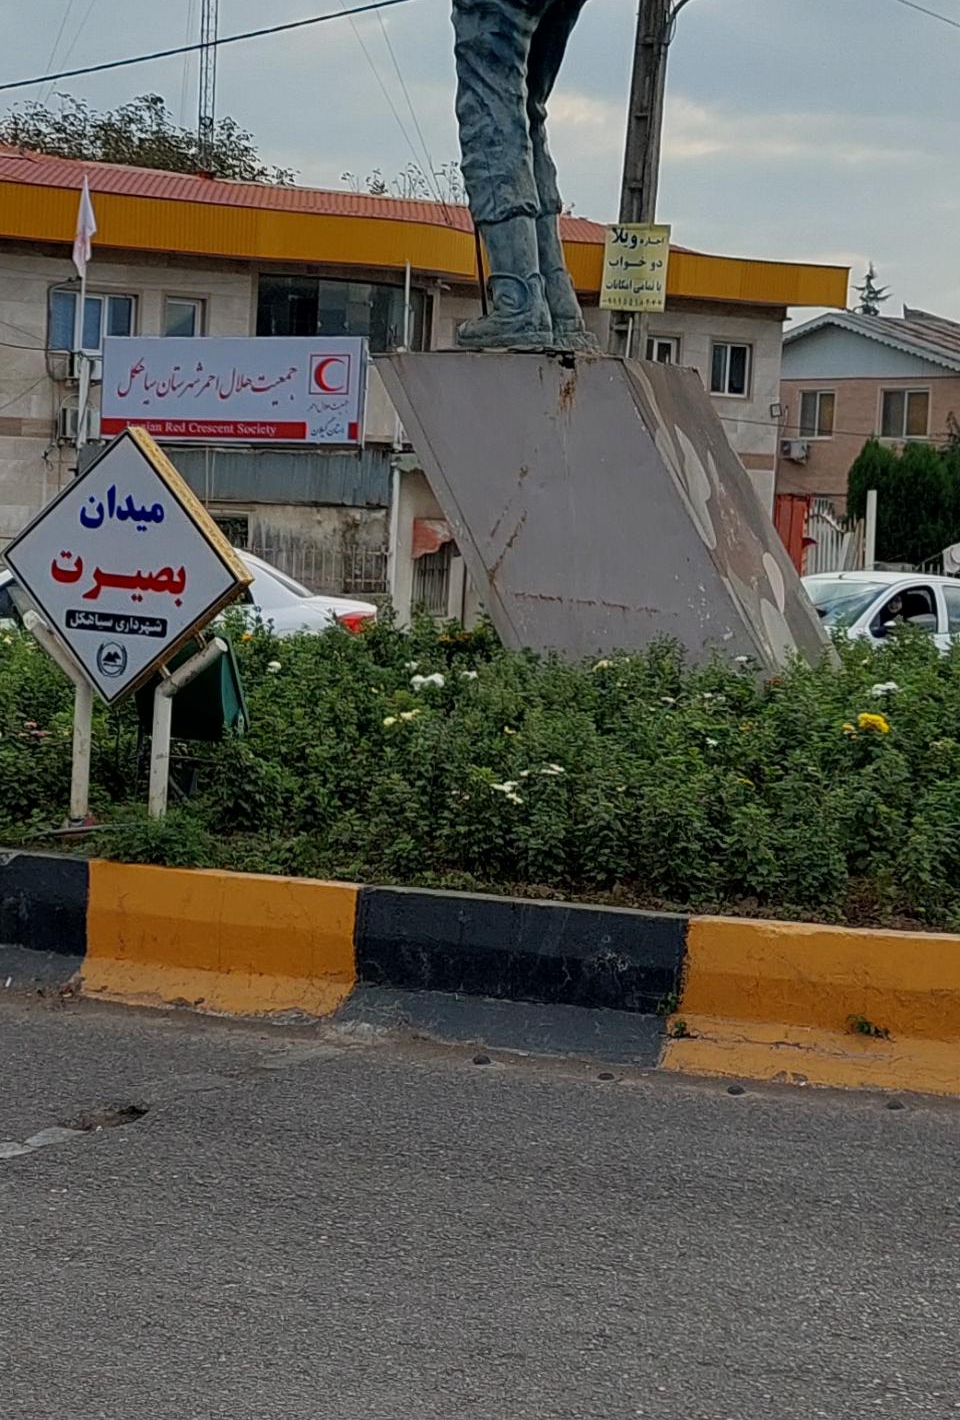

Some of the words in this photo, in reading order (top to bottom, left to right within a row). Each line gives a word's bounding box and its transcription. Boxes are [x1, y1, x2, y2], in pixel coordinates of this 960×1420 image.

[611, 226, 638, 249] ویلا
[608, 256, 646, 272] خواب
[649, 259, 663, 272] دو
[117, 356, 157, 405] سیاهکل
[156, 361, 204, 398] شهرستان
[194, 374, 220, 398] احمر
[219, 367, 252, 400] هلال
[250, 366, 298, 406] جمعیت
[165, 421, 186, 433] Red
[188, 422, 234, 434] Crescent
[236, 423, 277, 436] Society
[79, 483, 165, 532] میدان
[50, 550, 187, 608] بصیرت
[69, 611, 113, 630] سیاهکل
[115, 617, 163, 634] شهرداری
